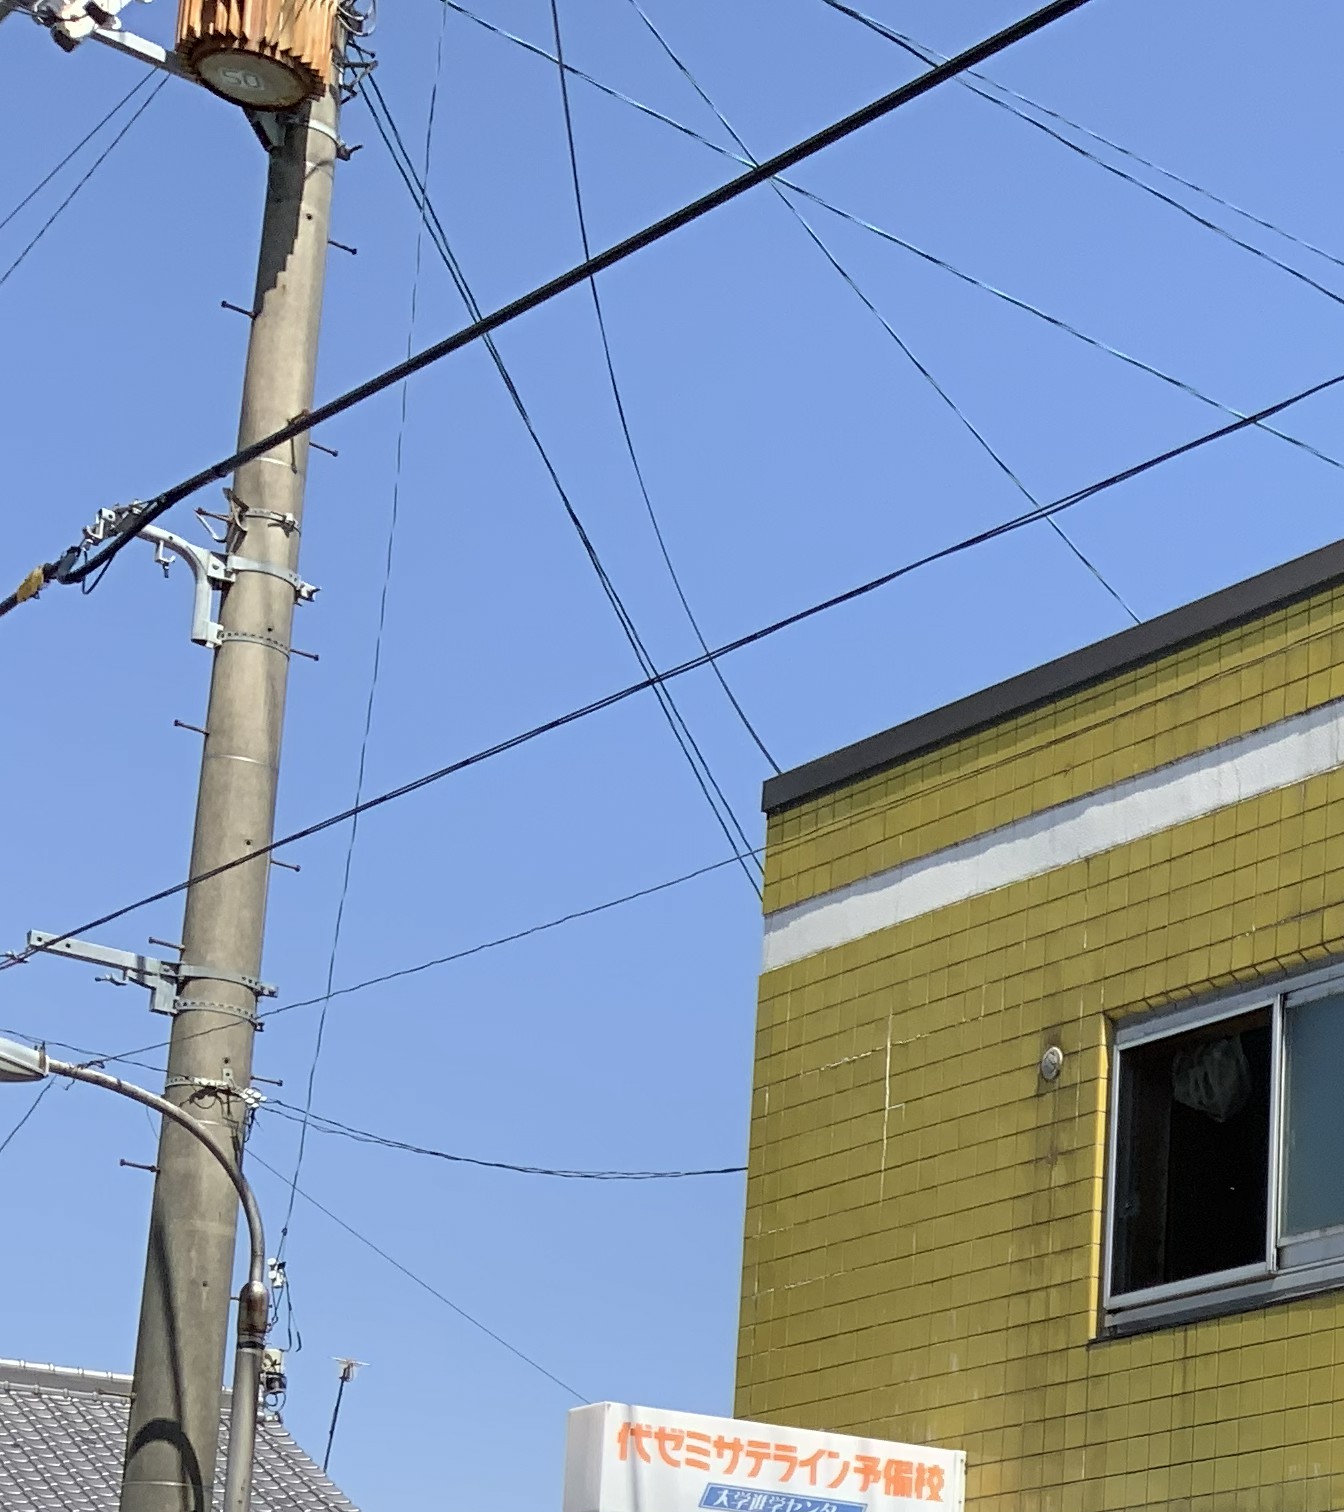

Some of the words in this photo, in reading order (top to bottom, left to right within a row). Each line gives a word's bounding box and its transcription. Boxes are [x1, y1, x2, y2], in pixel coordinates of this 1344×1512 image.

[617, 1421, 944, 1503] 代ゼミサテライン予備校
